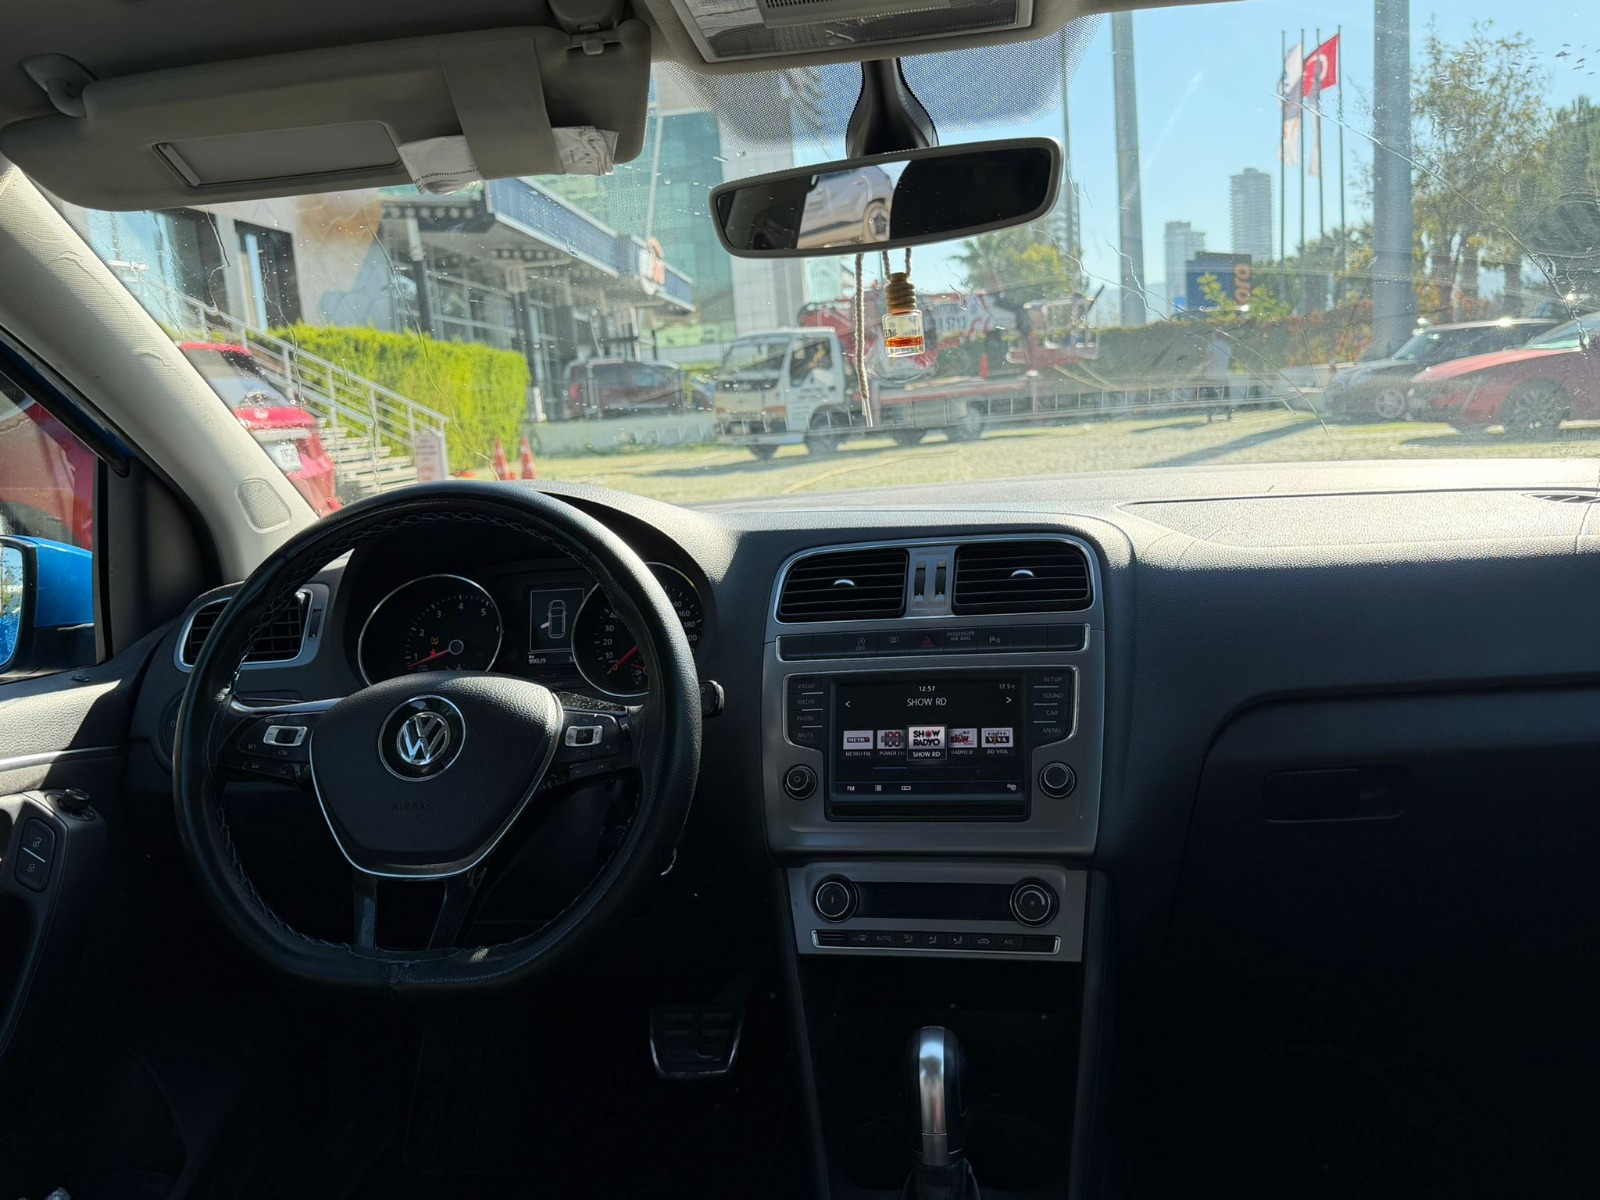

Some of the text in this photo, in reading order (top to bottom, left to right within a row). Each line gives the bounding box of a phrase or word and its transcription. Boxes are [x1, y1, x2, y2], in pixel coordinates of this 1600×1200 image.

[457, 602, 464, 610] 4
[436, 610, 442, 619] 3
[480, 608, 487, 617] 5
[604, 624, 615, 633] 30
[683, 620, 696, 629] 180
[419, 628, 425, 637] 2
[602, 638, 613, 647] 20
[605, 651, 614, 660] 10
[906, 697, 948, 708] SHOW RD
[913, 738, 941, 748] RADYO
[912, 750, 941, 759] SHOW RD
